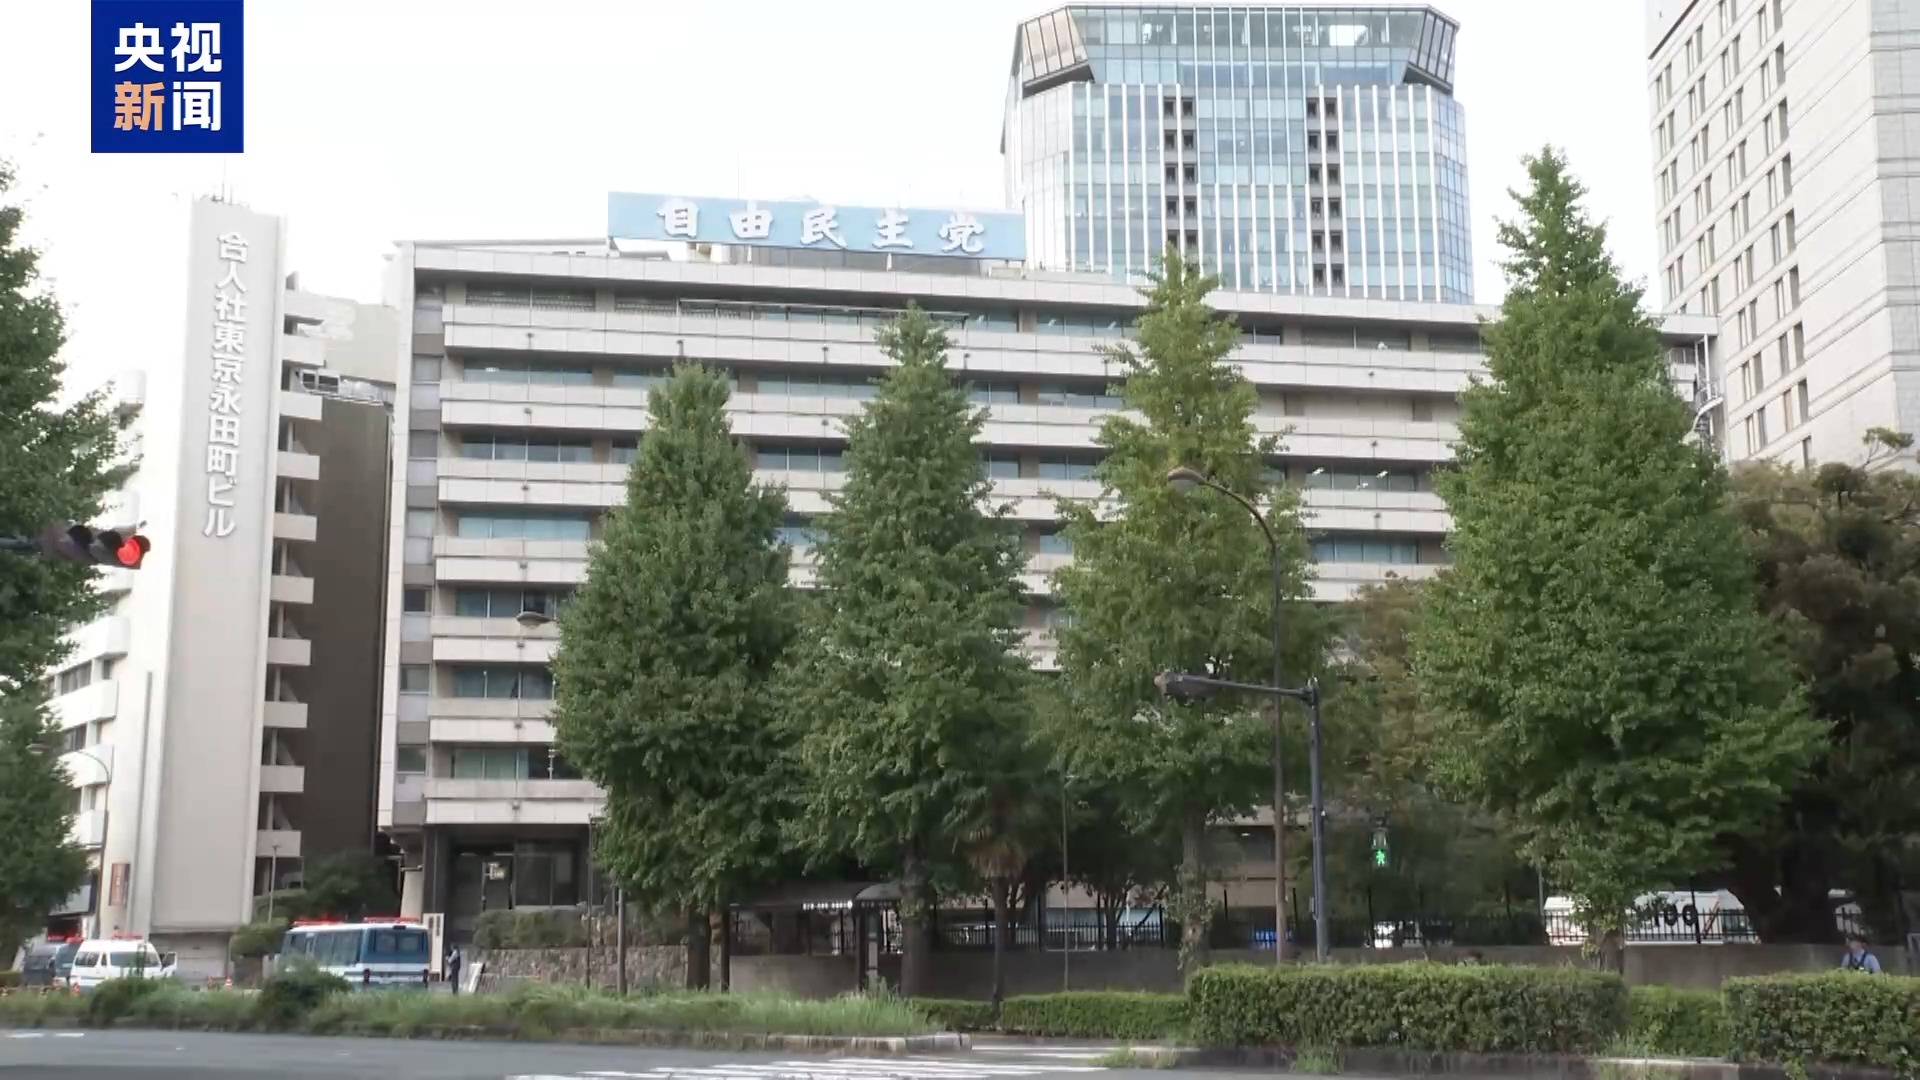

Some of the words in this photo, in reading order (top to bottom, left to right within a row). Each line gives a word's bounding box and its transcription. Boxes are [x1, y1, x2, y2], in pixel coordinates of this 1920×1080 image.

[657, 198, 985, 254] 自由民主党
[203, 231, 248, 538] 合人社東京永田町ビル
